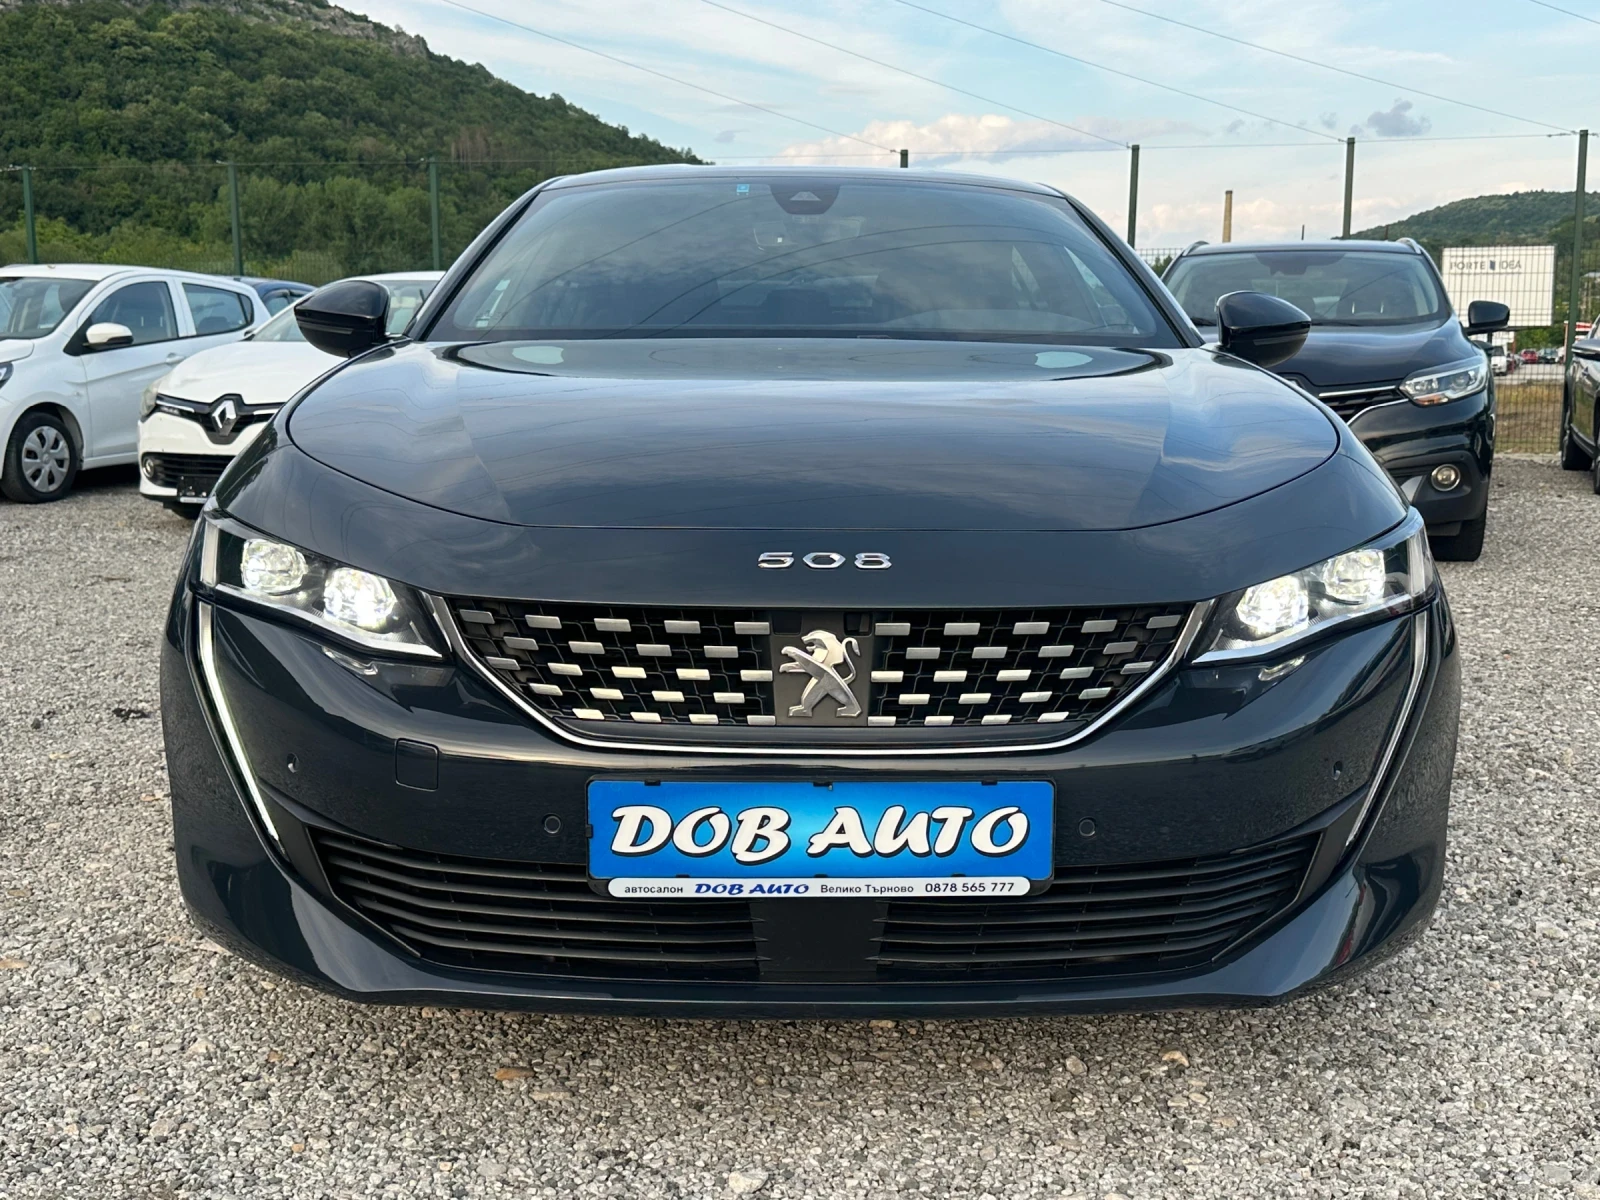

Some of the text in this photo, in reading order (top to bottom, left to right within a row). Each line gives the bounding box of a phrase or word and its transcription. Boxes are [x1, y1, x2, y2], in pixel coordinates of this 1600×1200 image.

[1450, 261, 1486, 271] PORTE
[757, 551, 893, 570] 508
[611, 804, 1031, 866] DOB AUTO
[624, 882, 1015, 895] автосалон DOB AUTO Велико Търново 0878 565 777
